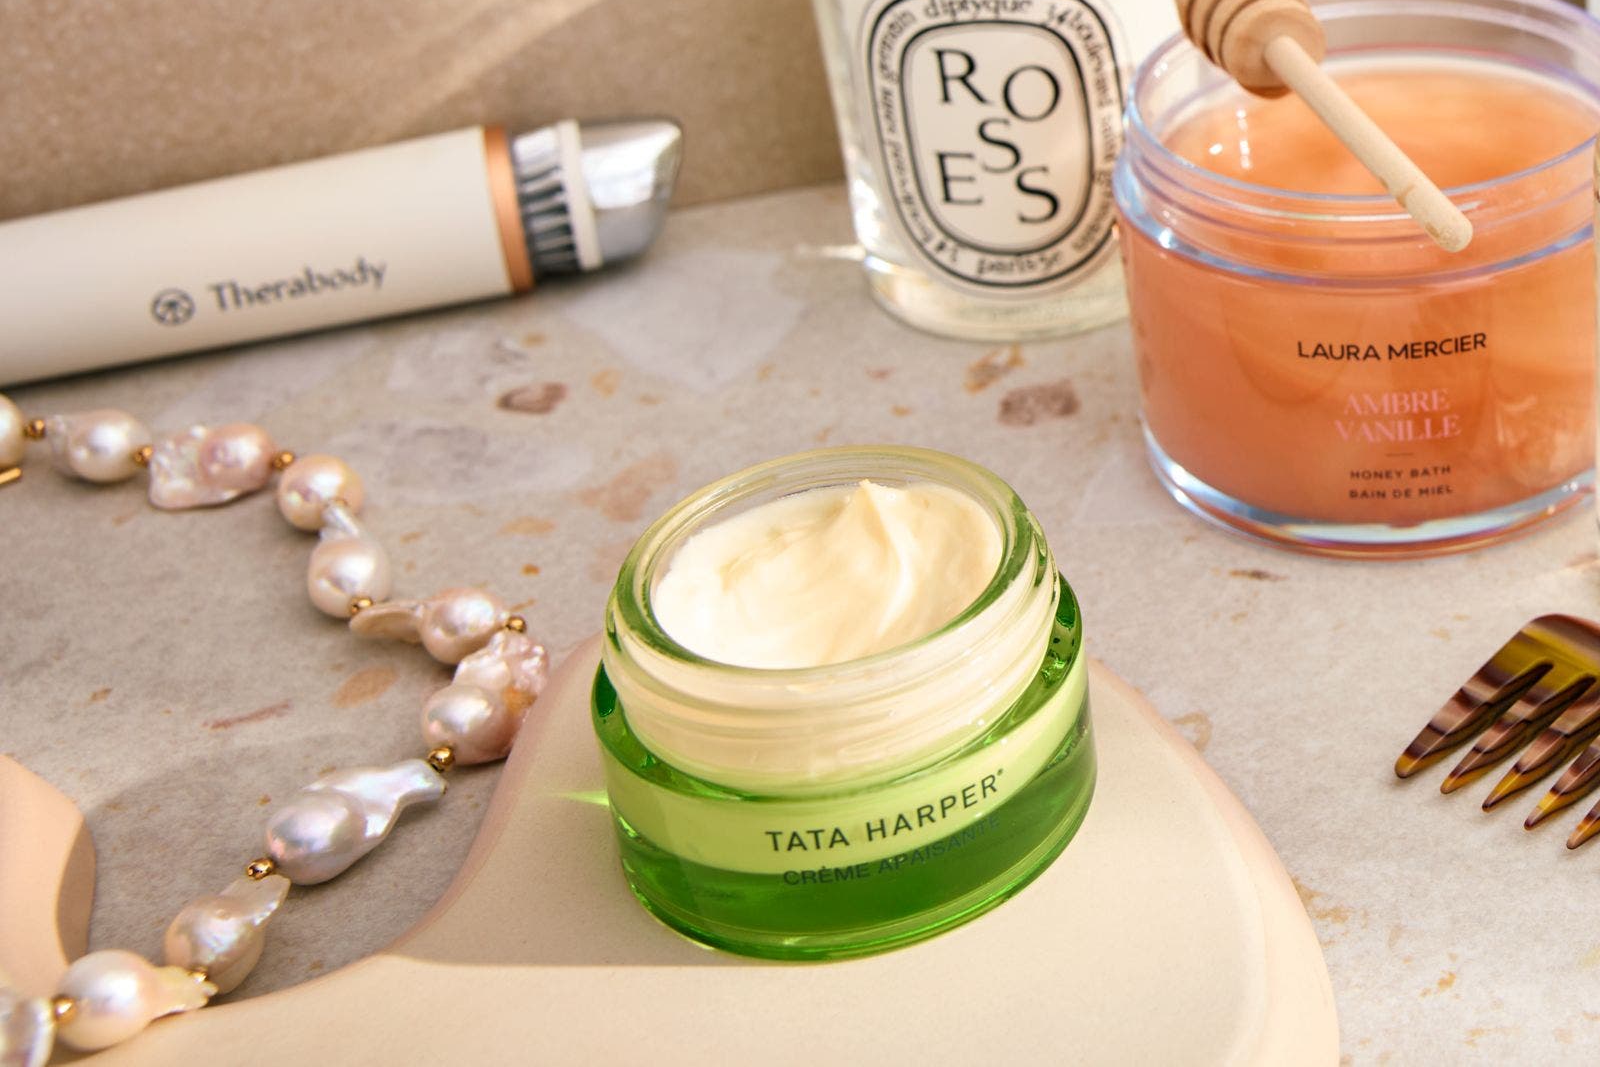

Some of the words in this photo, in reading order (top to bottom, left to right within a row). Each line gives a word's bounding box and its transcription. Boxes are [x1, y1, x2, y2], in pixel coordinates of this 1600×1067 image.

[209, 255, 387, 312] Therabody
[1297, 340, 1381, 361] LAURA
[1388, 331, 1487, 361] MERCIER
[1343, 388, 1450, 416] AMBRE
[1334, 414, 1462, 444] VANILLE
[1350, 469, 1404, 481] HONEY
[1410, 465, 1451, 479] BATH
[1349, 489, 1387, 499] BAIN
[1393, 488, 1412, 499] DE
[1418, 484, 1454, 496] MIEL
[764, 827, 850, 852] TATA
[865, 772, 1000, 843] HARPER
[783, 864, 870, 887] CRÈME
[877, 816, 1001, 874] APAISANTE
